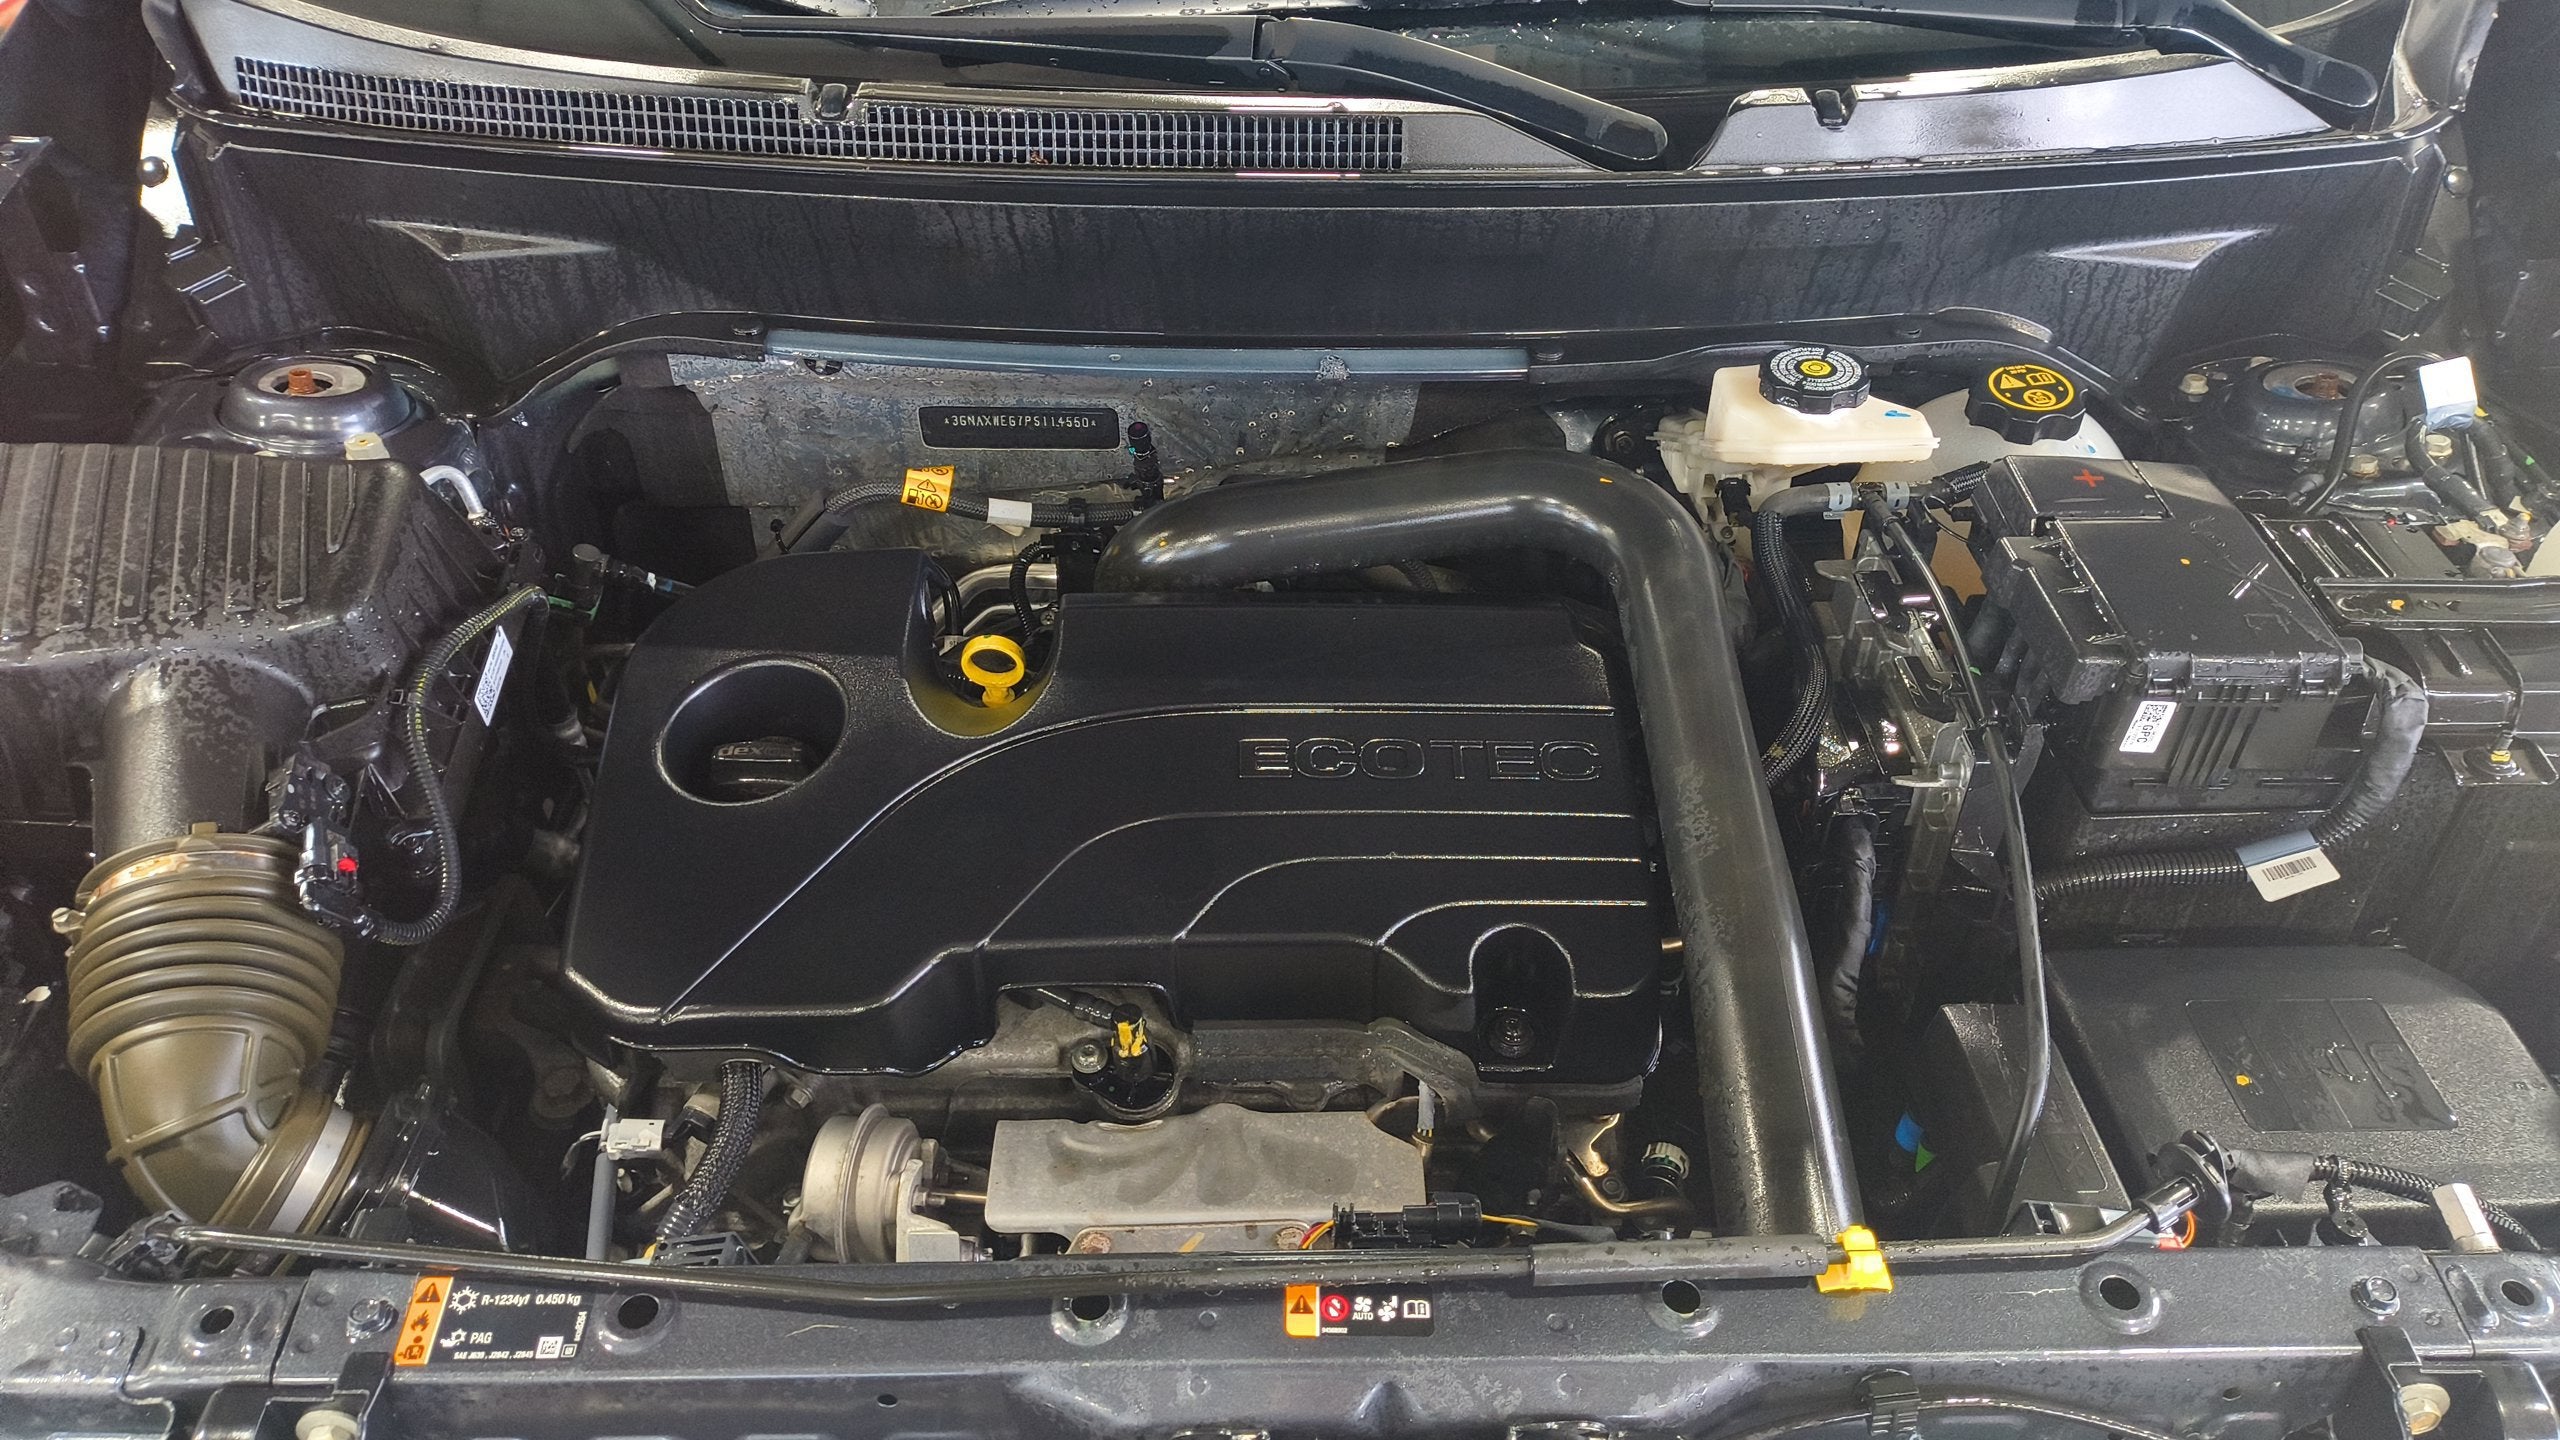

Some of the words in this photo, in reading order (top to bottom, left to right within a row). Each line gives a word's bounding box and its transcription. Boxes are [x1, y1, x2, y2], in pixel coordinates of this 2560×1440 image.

[2136, 724, 2154, 743] GPC
[1239, 737, 1601, 781] ECOTEC
[535, 1293, 565, 1305] 0.450
[566, 1293, 582, 1306] kg
[1352, 1312, 1374, 1321] AUTO
[470, 1332, 493, 1344] PAG
